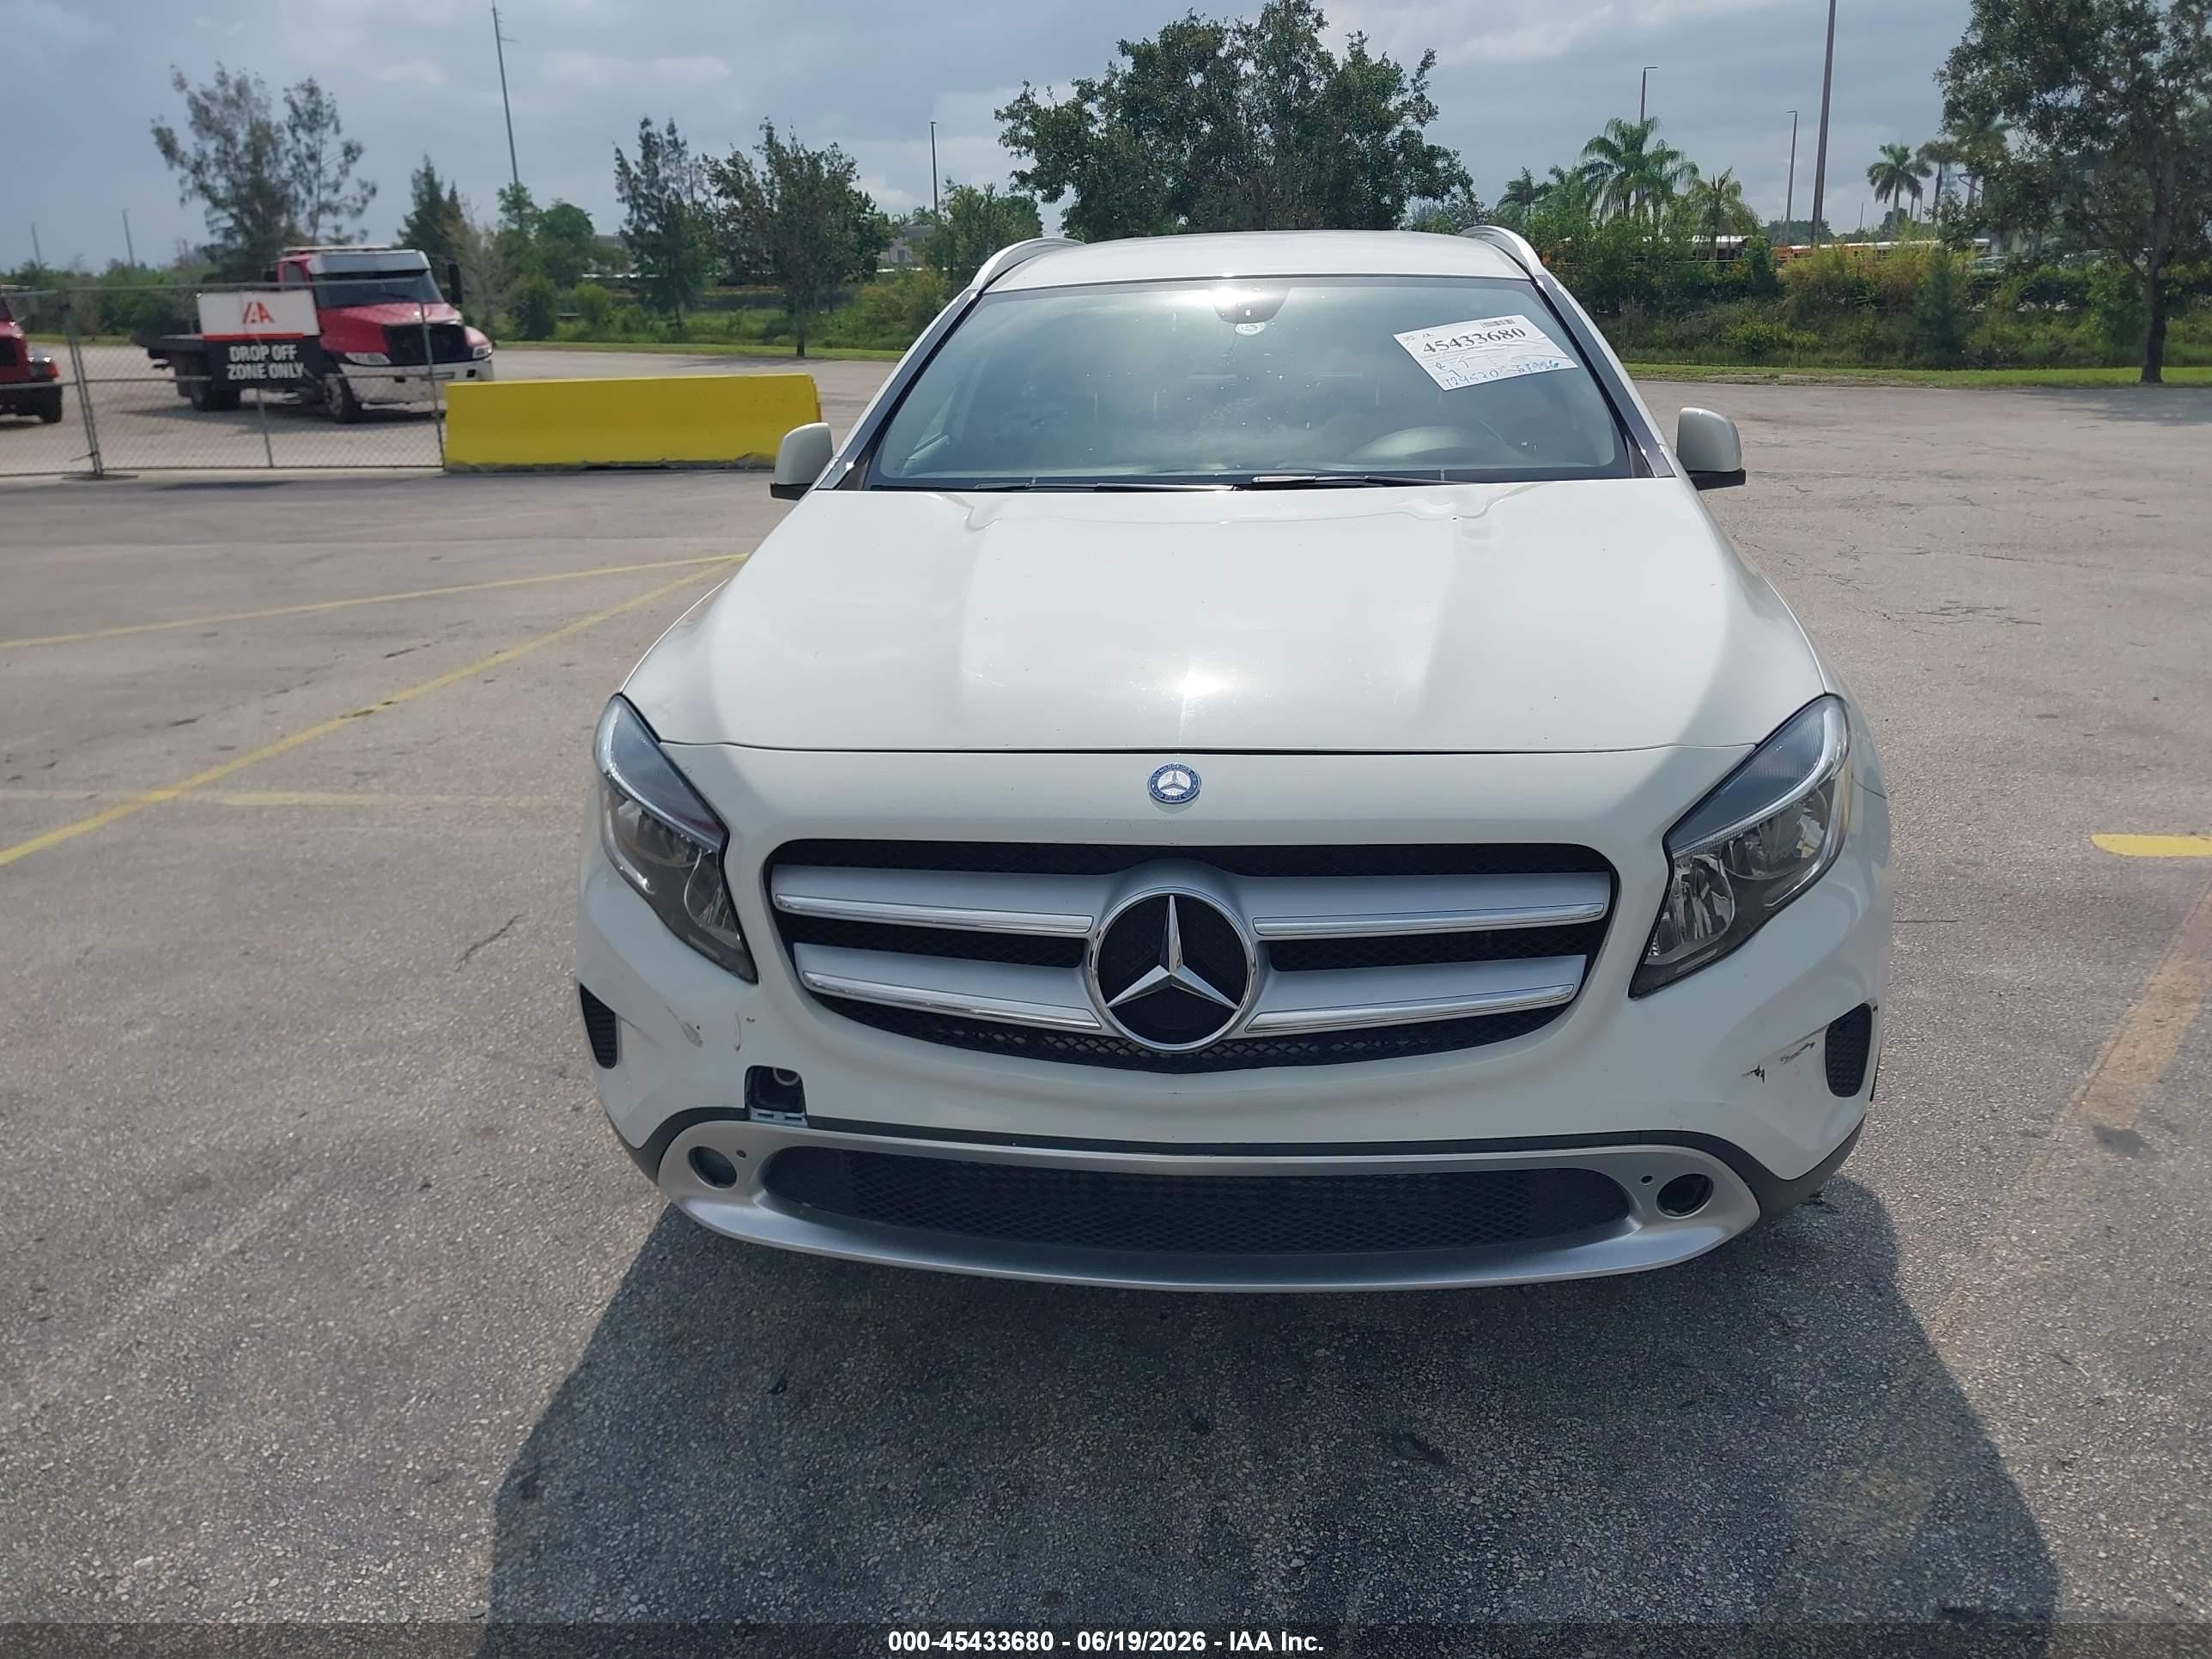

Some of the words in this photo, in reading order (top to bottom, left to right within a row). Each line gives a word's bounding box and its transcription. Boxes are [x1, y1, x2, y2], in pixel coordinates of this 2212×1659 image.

[1423, 327, 1526, 354] 45433680
[228, 344, 270, 362] DROP
[271, 344, 297, 360] OFF
[227, 362, 267, 380] ZONE
[268, 362, 304, 379] ONLY
